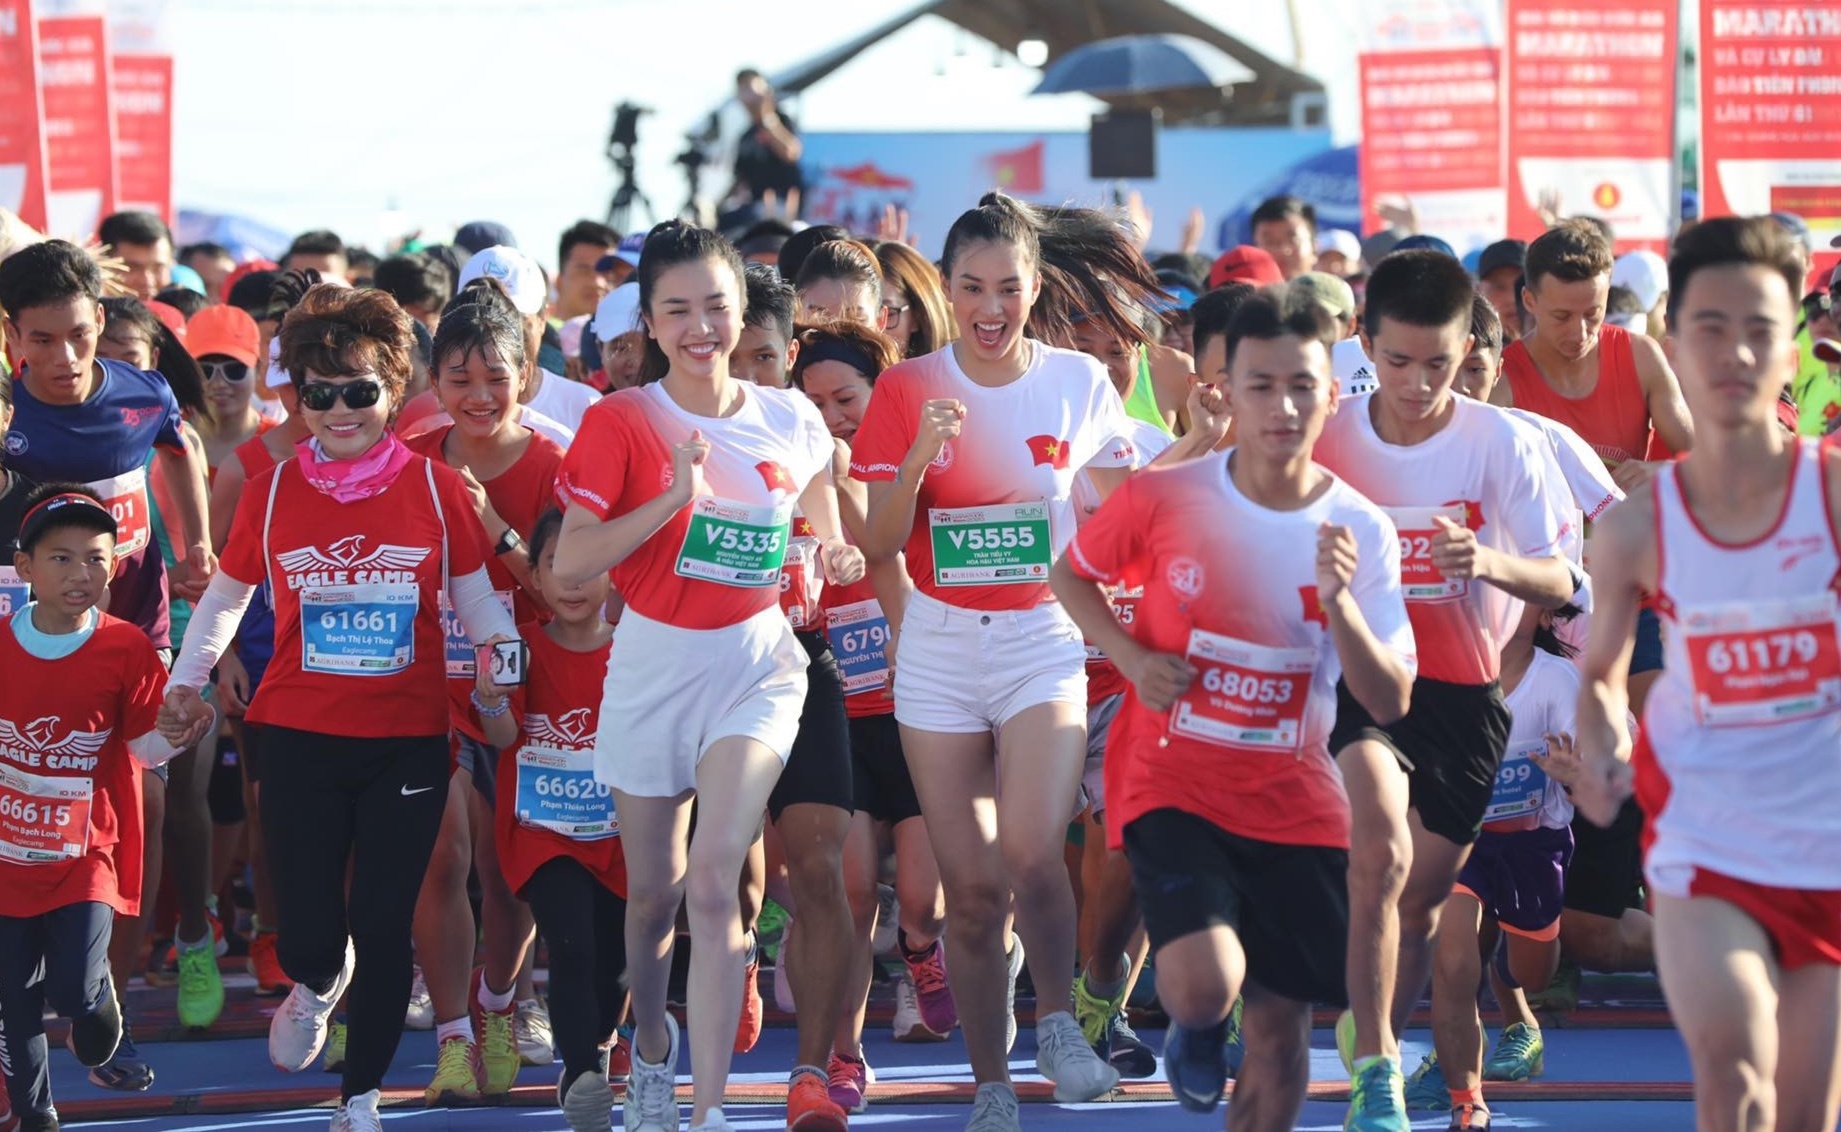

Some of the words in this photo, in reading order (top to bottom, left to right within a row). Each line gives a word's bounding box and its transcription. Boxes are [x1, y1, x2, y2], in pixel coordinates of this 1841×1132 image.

[705, 523, 782, 553] V5335
[947, 526, 1035, 550] V5555
[286, 571, 348, 590] EAGLE
[354, 570, 416, 585] CAMP
[320, 610, 397, 633] 61661
[326, 633, 346, 644] Bạch
[348, 634, 361, 645] Thị
[374, 636, 394, 645] Thoa
[1707, 630, 1818, 674] 61179
[1203, 667, 1293, 704] 68053
[0, 742, 41, 767] AGLE
[46, 754, 98, 771] CAMP
[535, 774, 611, 799] 66620
[0, 794, 70, 826] 66615
[586, 803, 606, 811] Long
[20, 827, 40, 836] Bạch
[41, 830, 62, 840] Long
